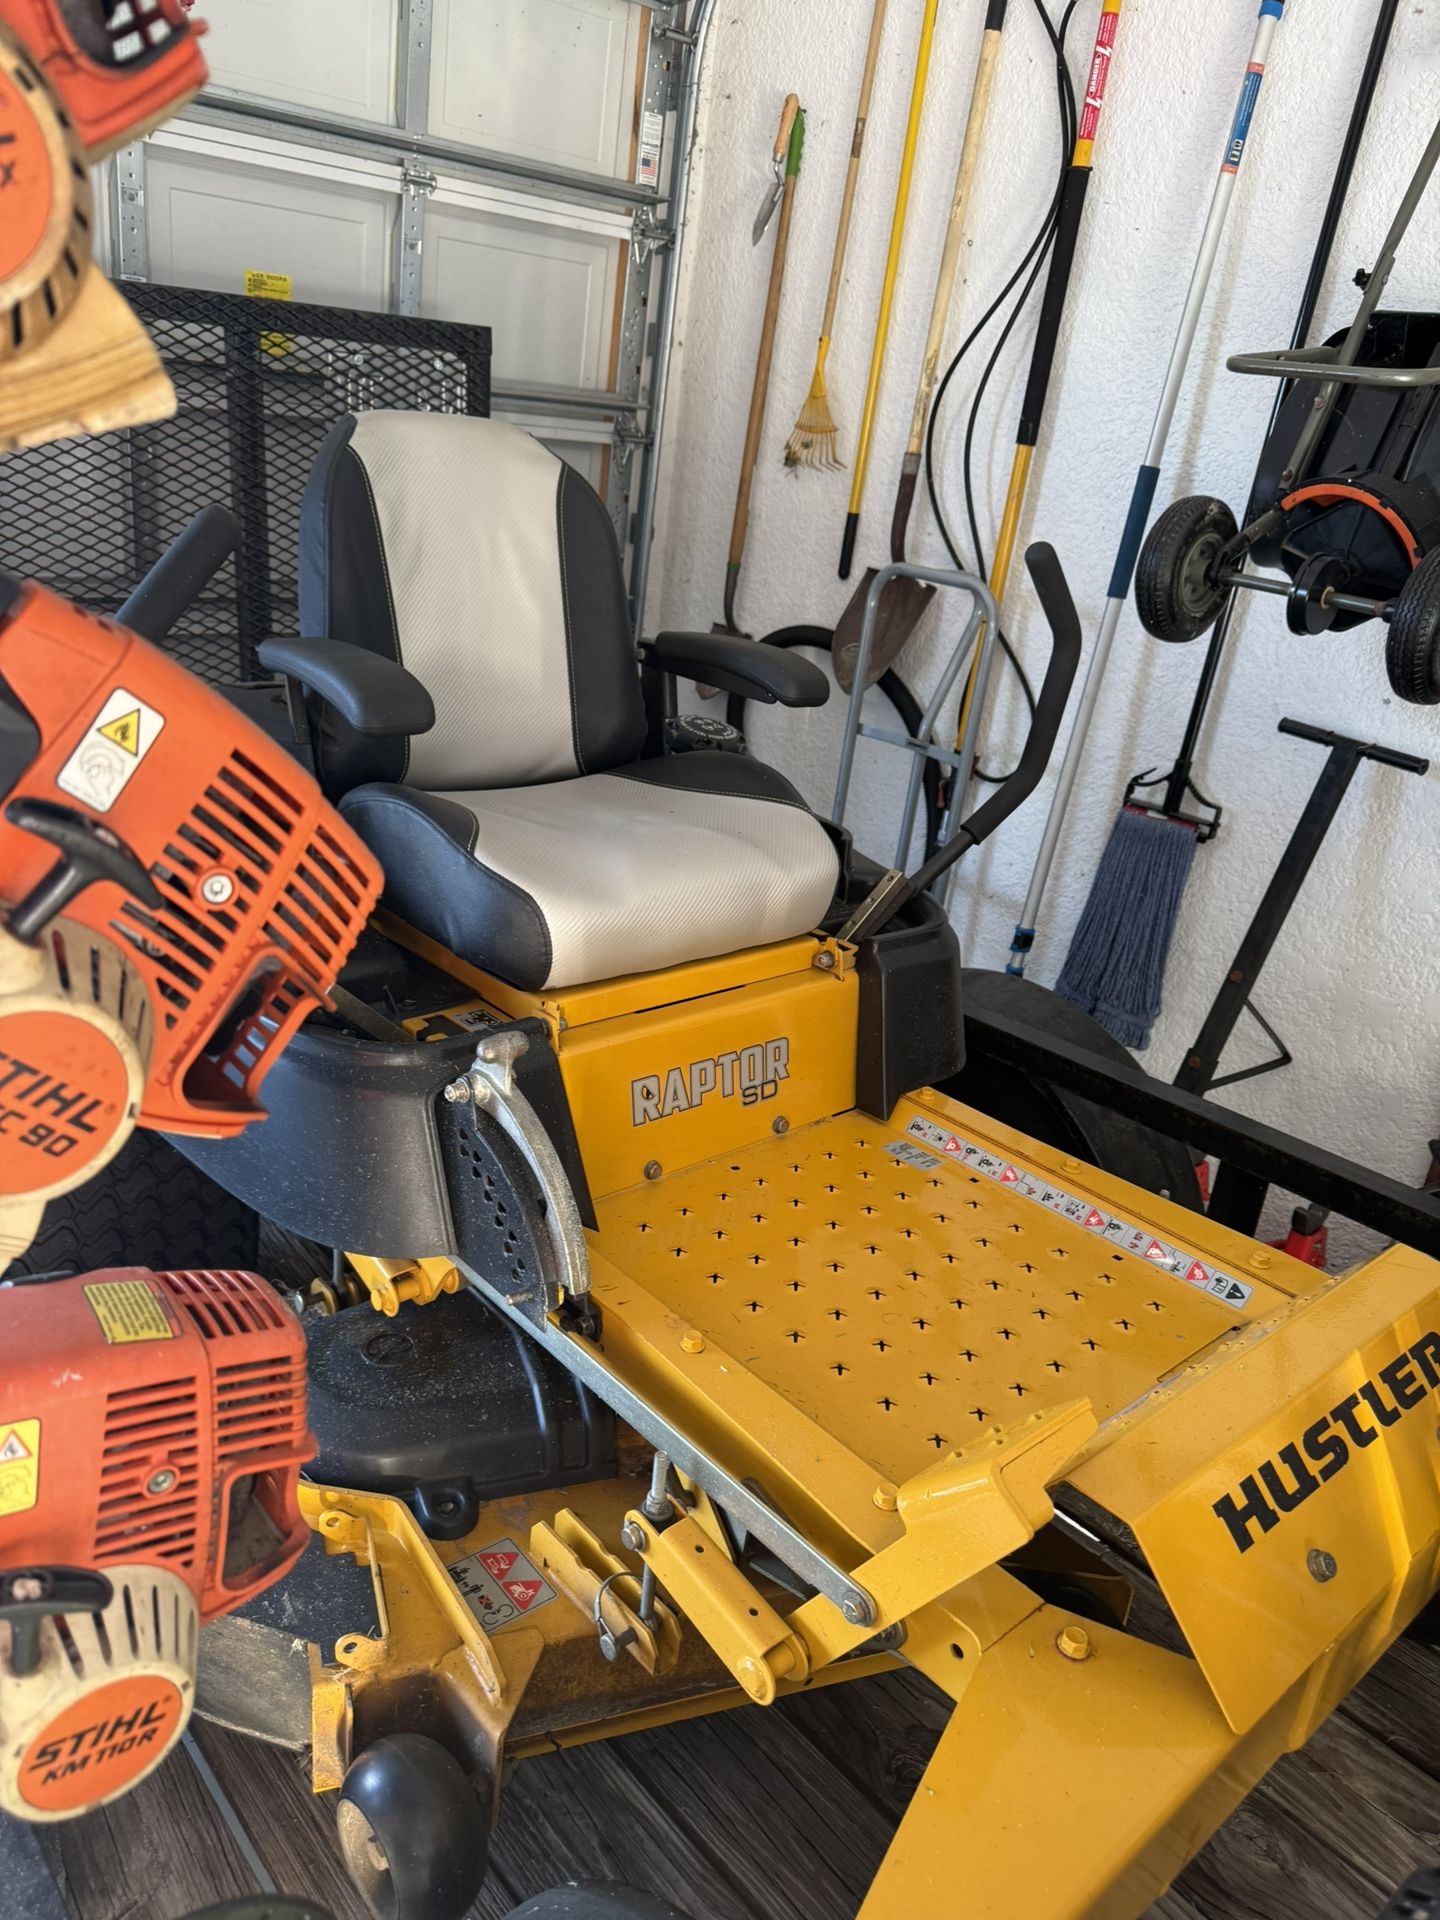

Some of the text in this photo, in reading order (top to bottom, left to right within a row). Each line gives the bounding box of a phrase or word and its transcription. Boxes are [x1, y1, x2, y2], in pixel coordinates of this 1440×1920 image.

[1089, 56, 1101, 93] DANGER
[0, 1052, 103, 1134] TIHL
[632, 1036, 790, 1127] RAPTOR
[741, 1079, 778, 1106] SD
[19, 1123, 79, 1157] 90
[28, 1701, 166, 1772] STIHL
